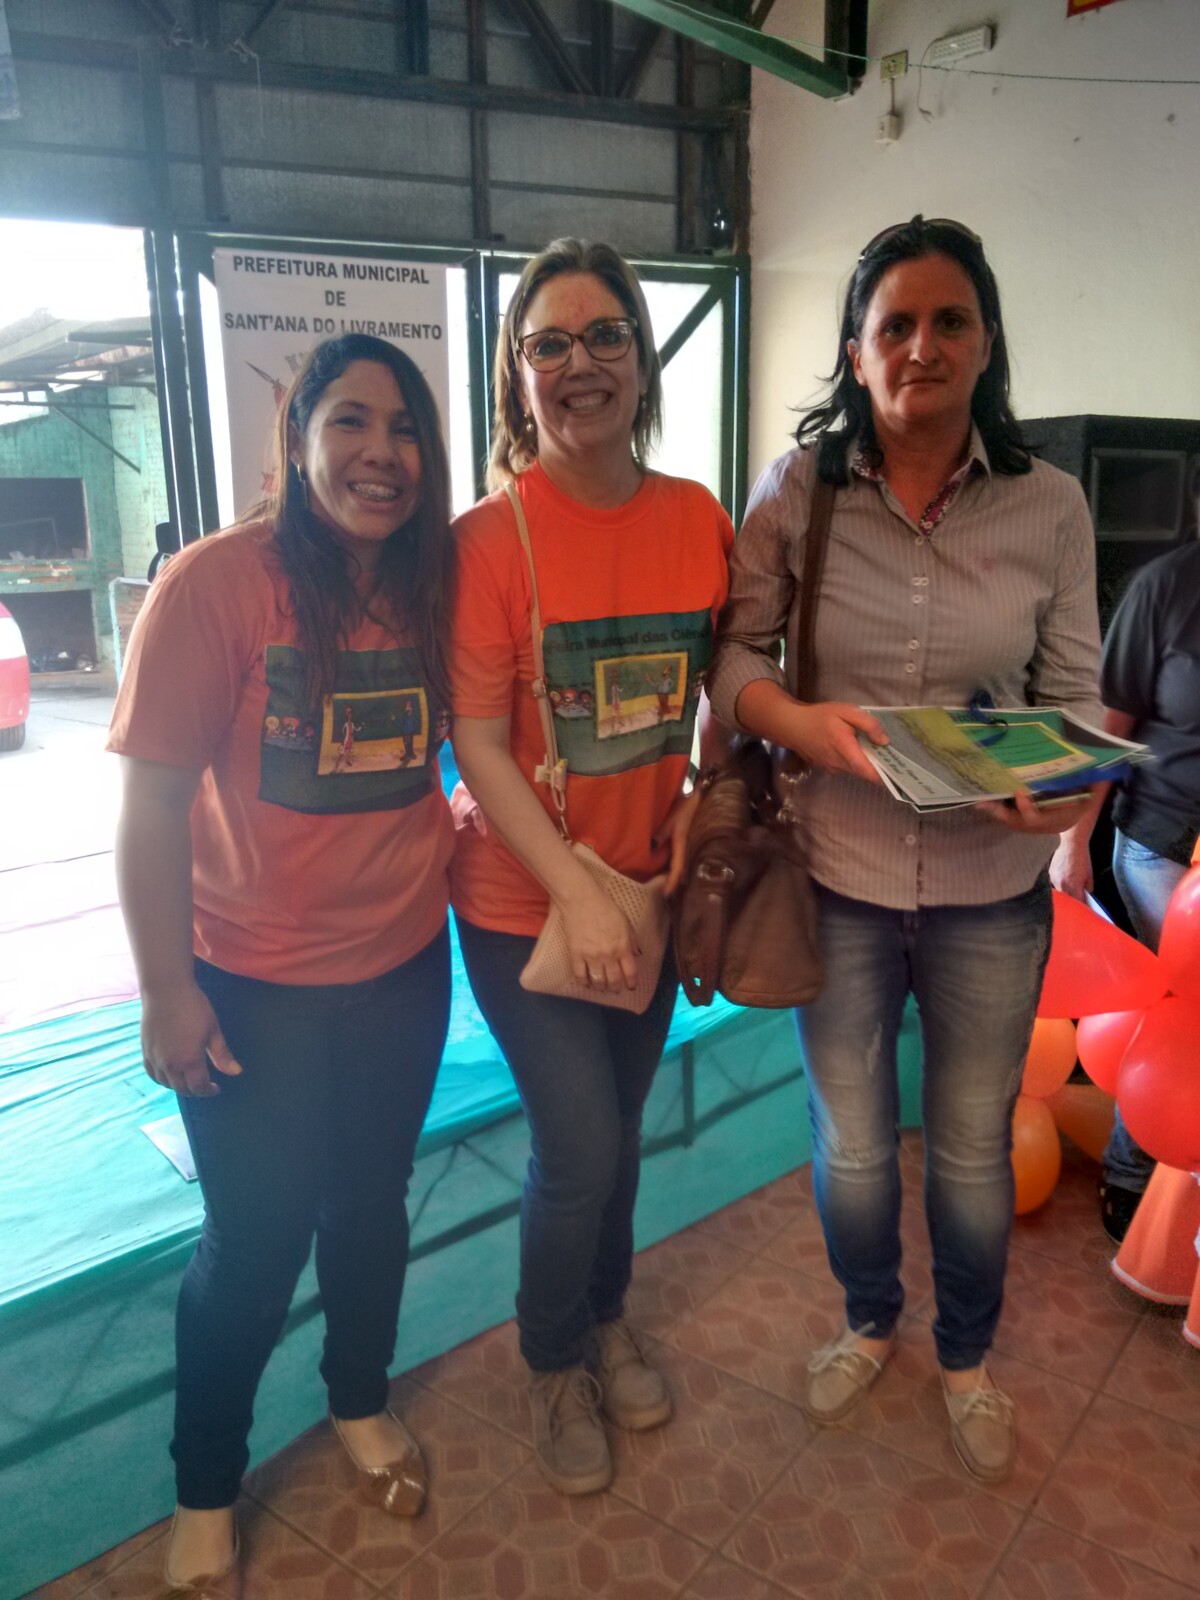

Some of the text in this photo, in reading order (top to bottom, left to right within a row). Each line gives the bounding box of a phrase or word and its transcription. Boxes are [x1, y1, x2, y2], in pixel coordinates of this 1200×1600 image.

[233, 255, 430, 284] PREFEITURA MUNICIPAL
[325, 290, 346, 307] DE
[224, 312, 442, 340] SANT'ANA DO LIVRAMENTO
[642, 630, 668, 643] das
